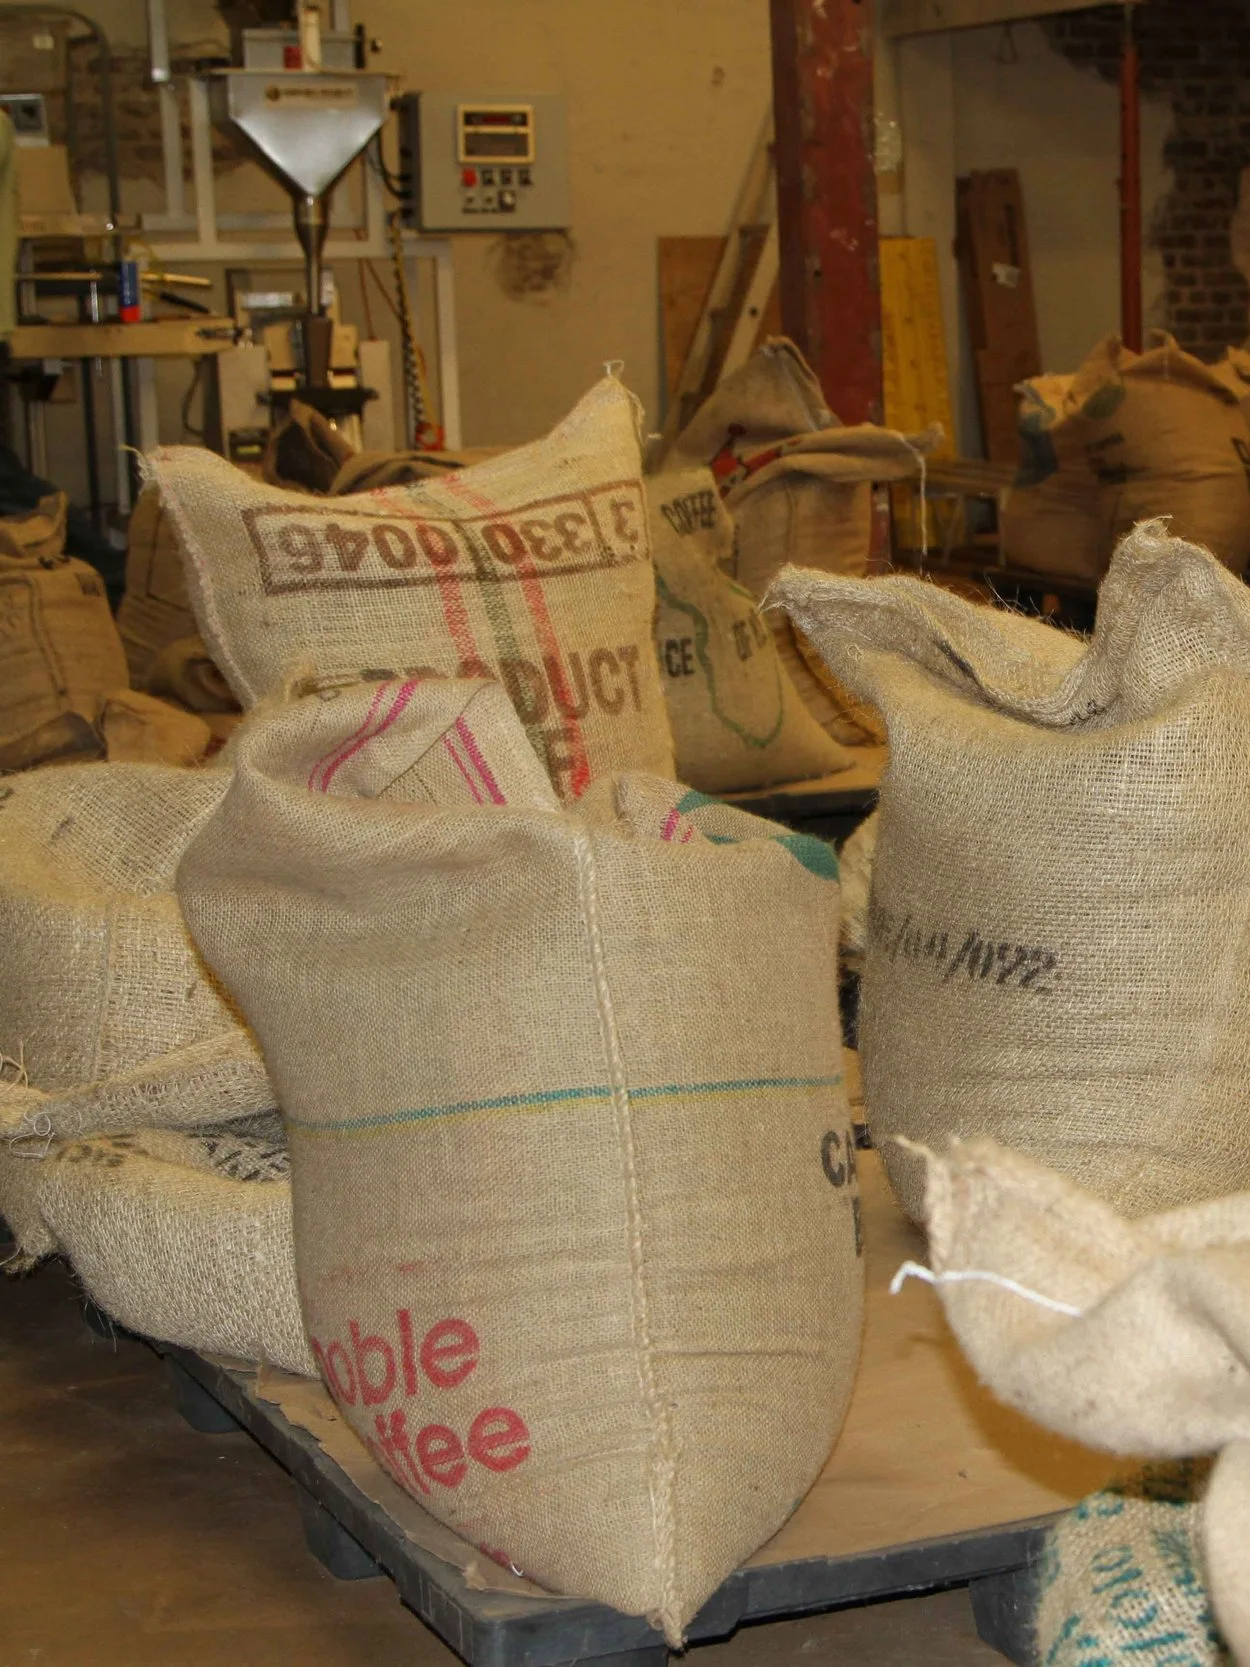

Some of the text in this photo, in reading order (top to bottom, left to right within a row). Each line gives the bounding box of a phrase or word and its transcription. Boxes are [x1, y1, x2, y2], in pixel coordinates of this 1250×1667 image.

[660, 489, 716, 536] COFFEE
[480, 511, 590, 566] 330
[665, 637, 695, 678] CE
[368, 1406, 531, 1495] ffee
